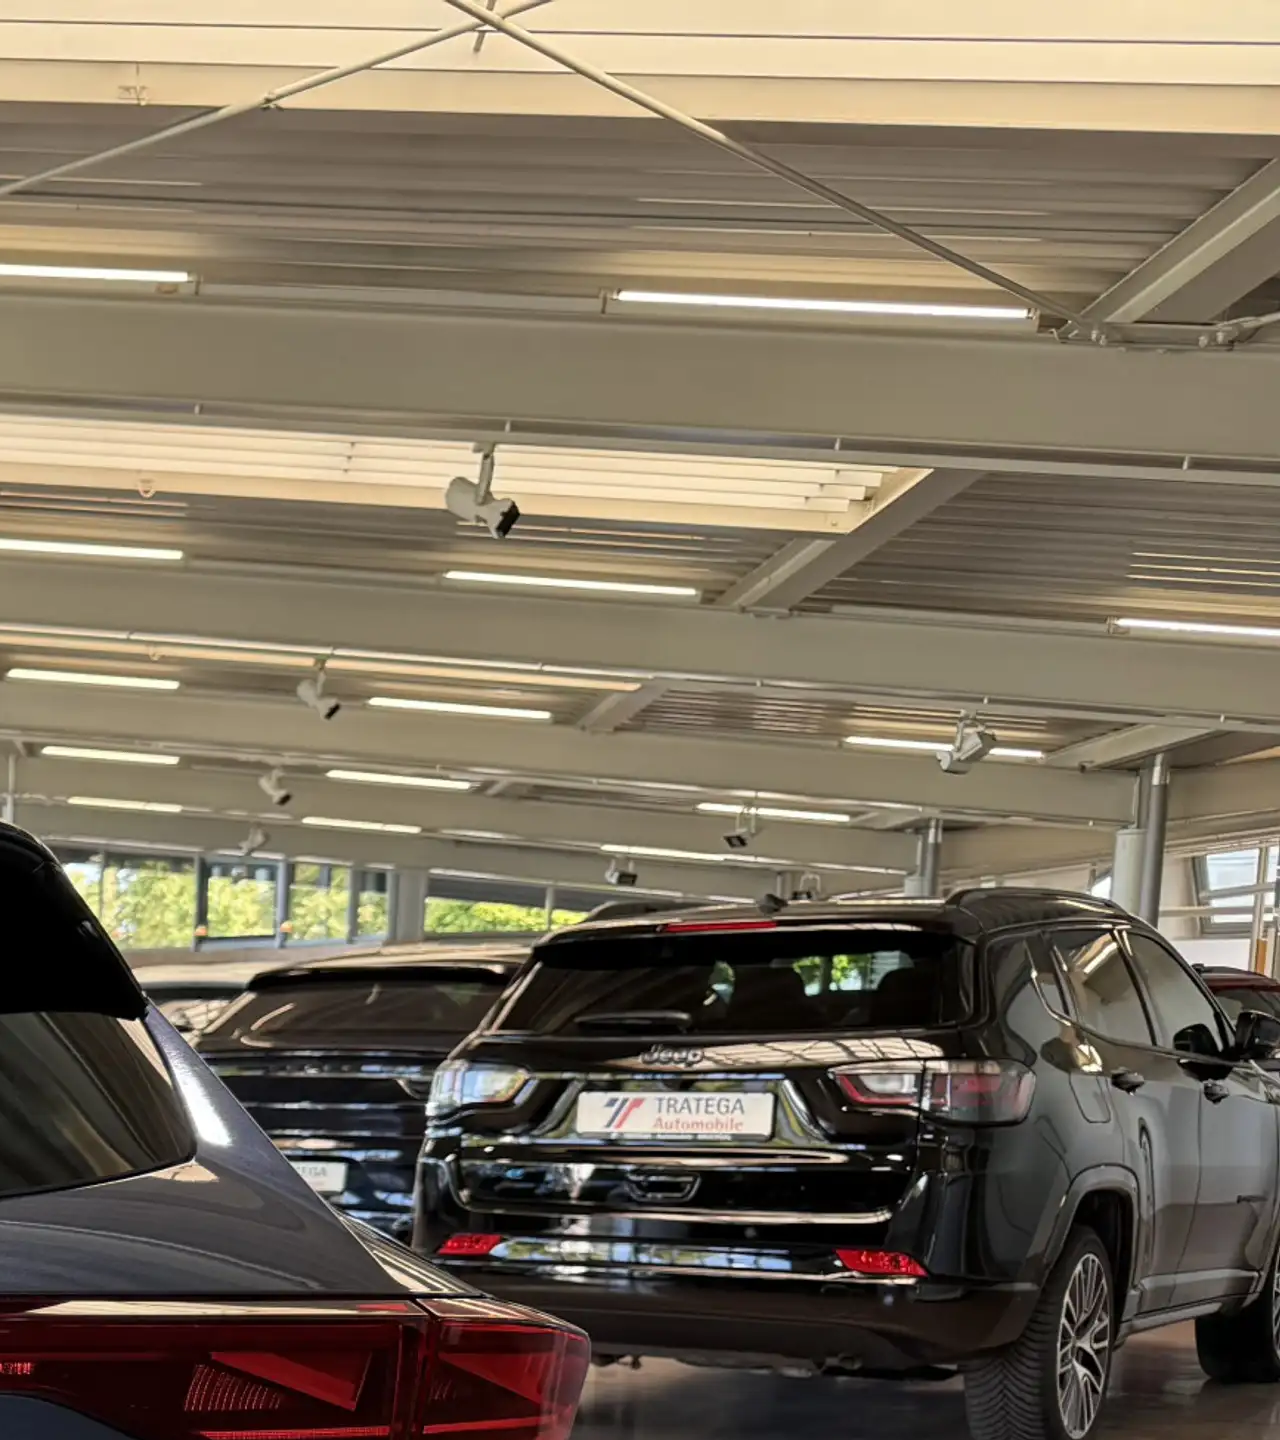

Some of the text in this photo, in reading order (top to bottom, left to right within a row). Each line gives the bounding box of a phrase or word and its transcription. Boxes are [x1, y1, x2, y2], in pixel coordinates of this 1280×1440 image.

[641, 1043, 704, 1067] Jeep
[654, 1096, 745, 1114] TRATEGA
[652, 1114, 744, 1131] Automobile
